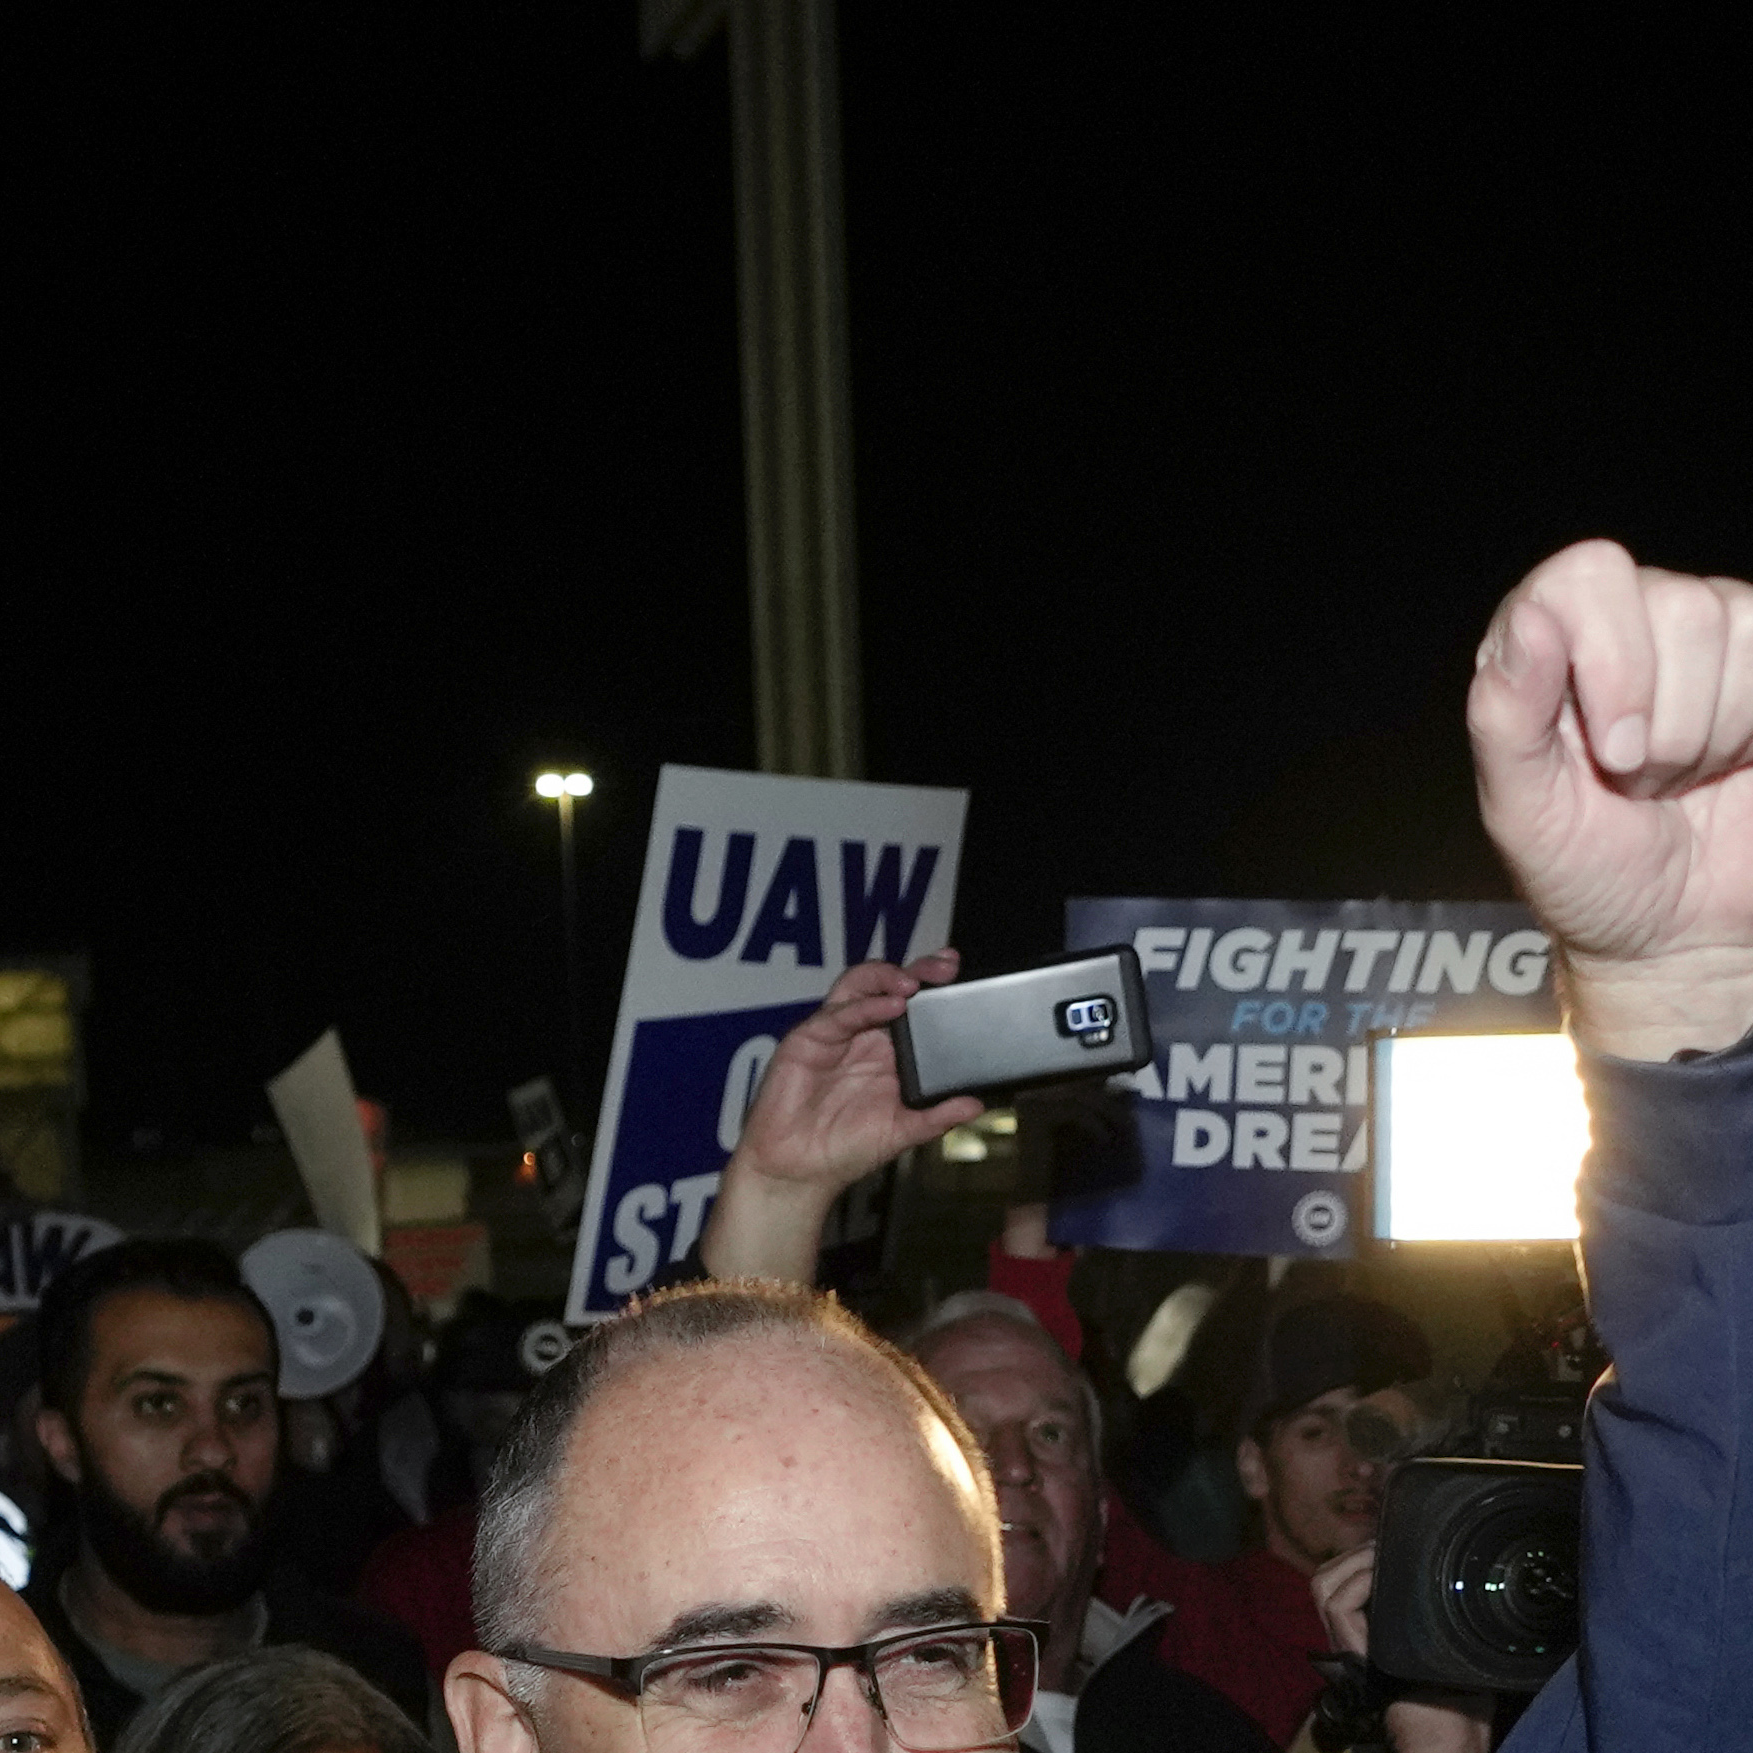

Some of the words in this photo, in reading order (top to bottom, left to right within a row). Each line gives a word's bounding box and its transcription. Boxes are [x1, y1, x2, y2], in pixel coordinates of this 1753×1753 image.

[662, 826, 940, 967] UAW
[1133, 927, 1550, 995] FIGHTING
[1231, 1001, 1329, 1034] FOR
[1347, 1002, 1438, 1030] THE
[1171, 1108, 1368, 1171] DRE
